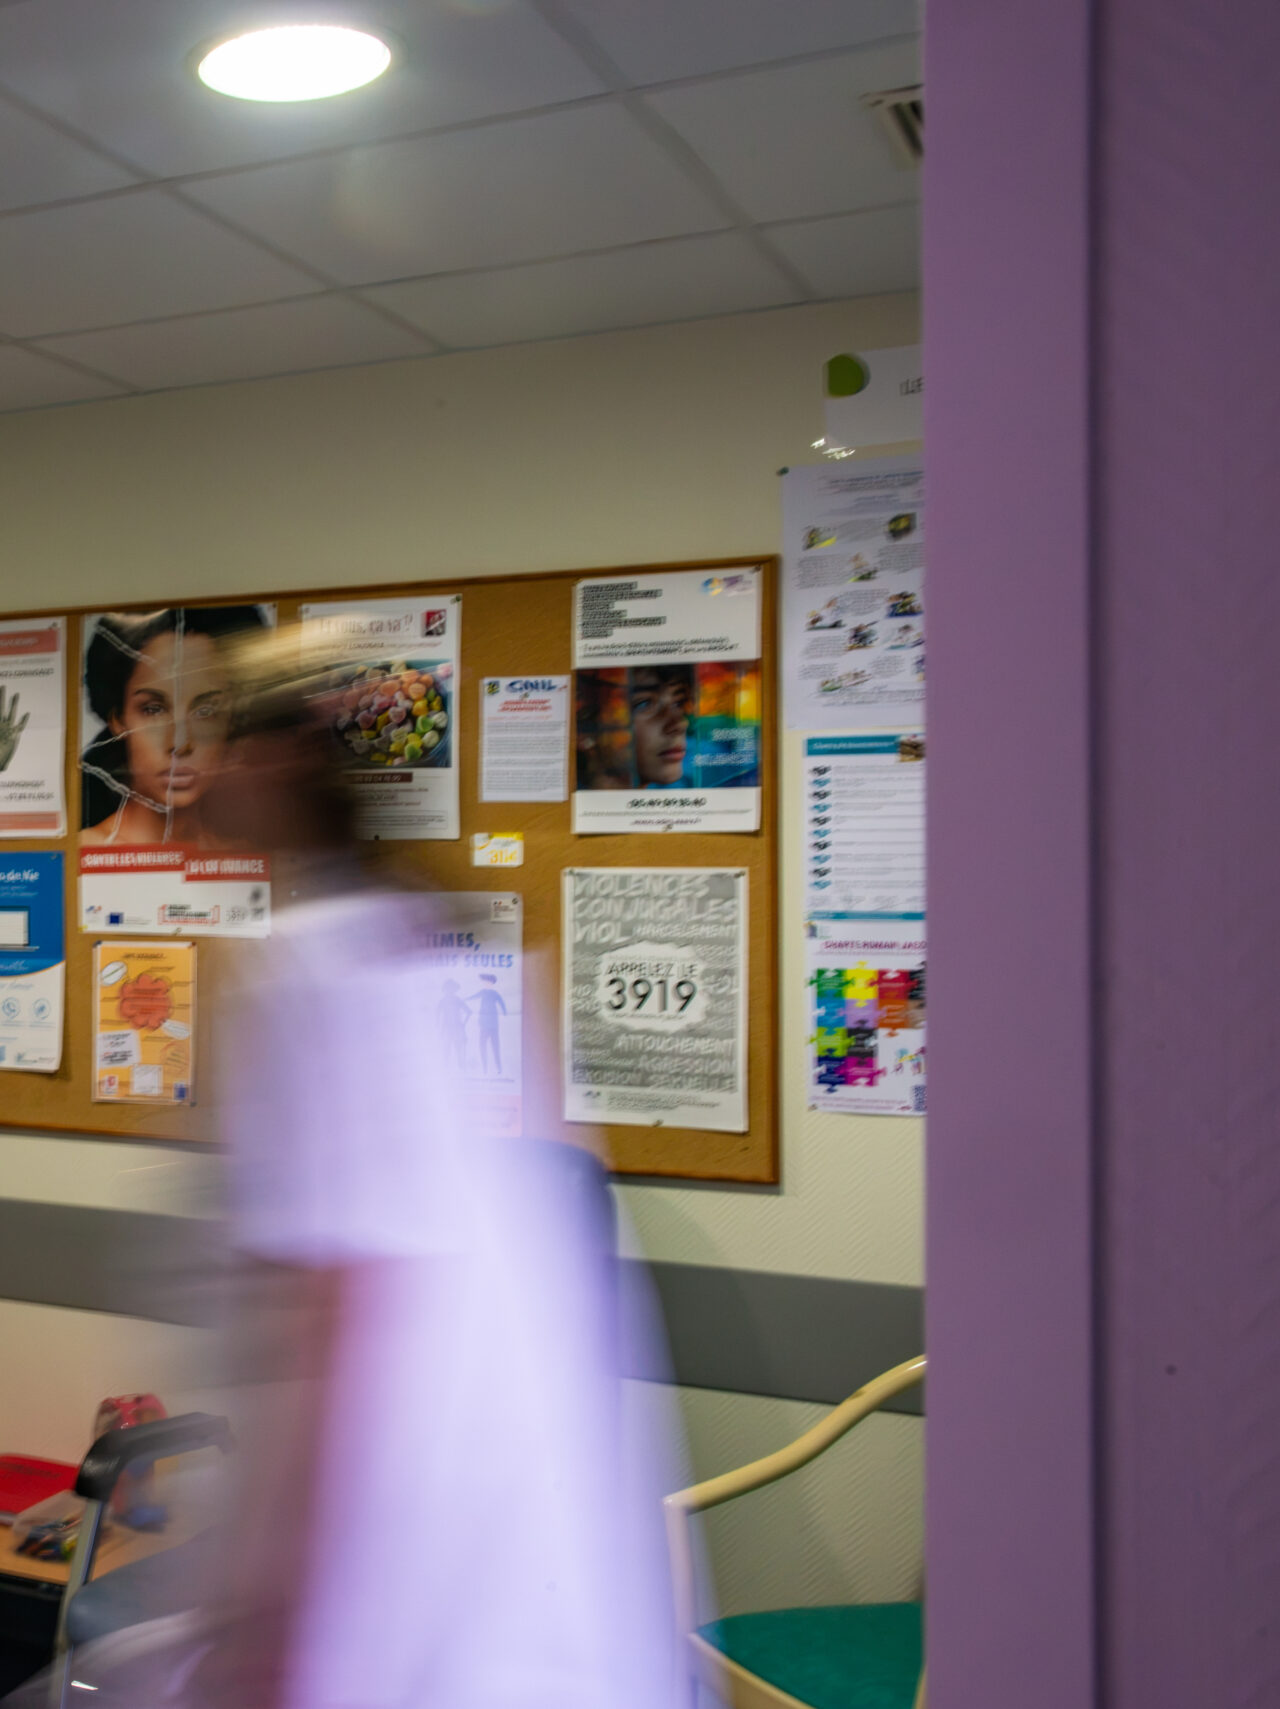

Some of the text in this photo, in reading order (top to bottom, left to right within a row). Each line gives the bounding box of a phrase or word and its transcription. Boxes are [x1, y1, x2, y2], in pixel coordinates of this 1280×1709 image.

[573, 873, 710, 898] VIOLENCES
[574, 897, 738, 922] CONJUGALES
[606, 961, 677, 977] APPELEZ
[606, 977, 698, 1013] 3919
